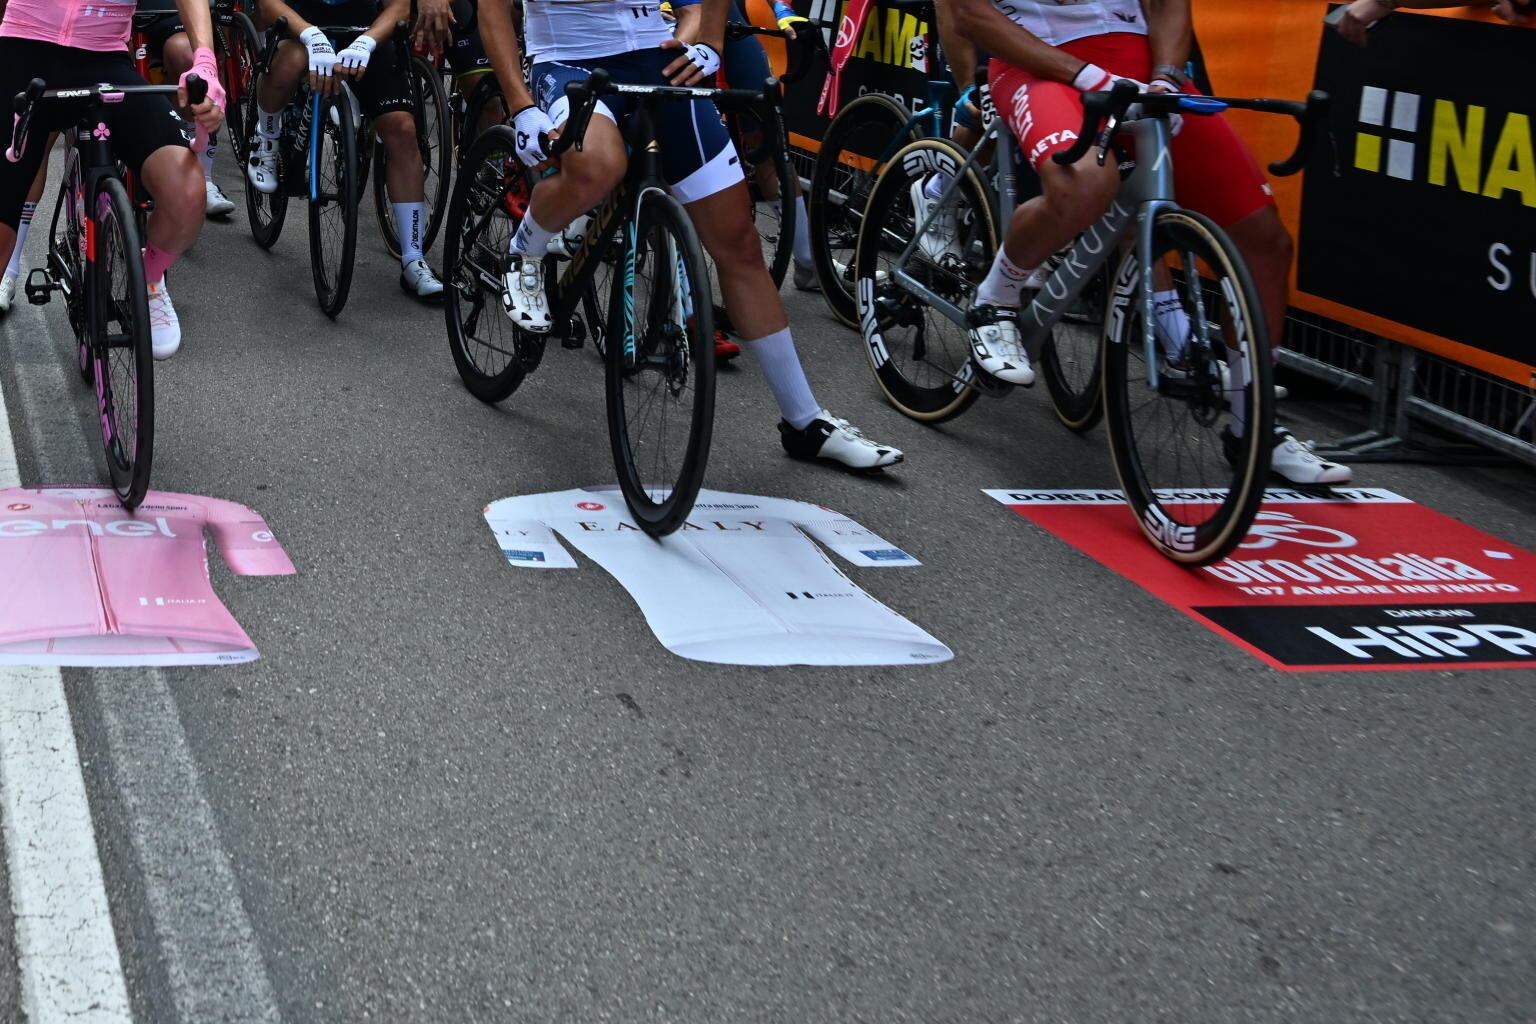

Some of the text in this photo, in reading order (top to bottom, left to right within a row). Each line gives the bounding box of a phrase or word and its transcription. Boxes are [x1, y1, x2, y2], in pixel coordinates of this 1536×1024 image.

[910, 39, 924, 62] 32
[1011, 83, 1034, 142] POLTI
[1030, 200, 1129, 327] AURUM
[576, 521, 765, 532] EAALY
[1314, 553, 1494, 581] d'Italia
[1237, 582, 1520, 596] 107 AMORE INFINITO
